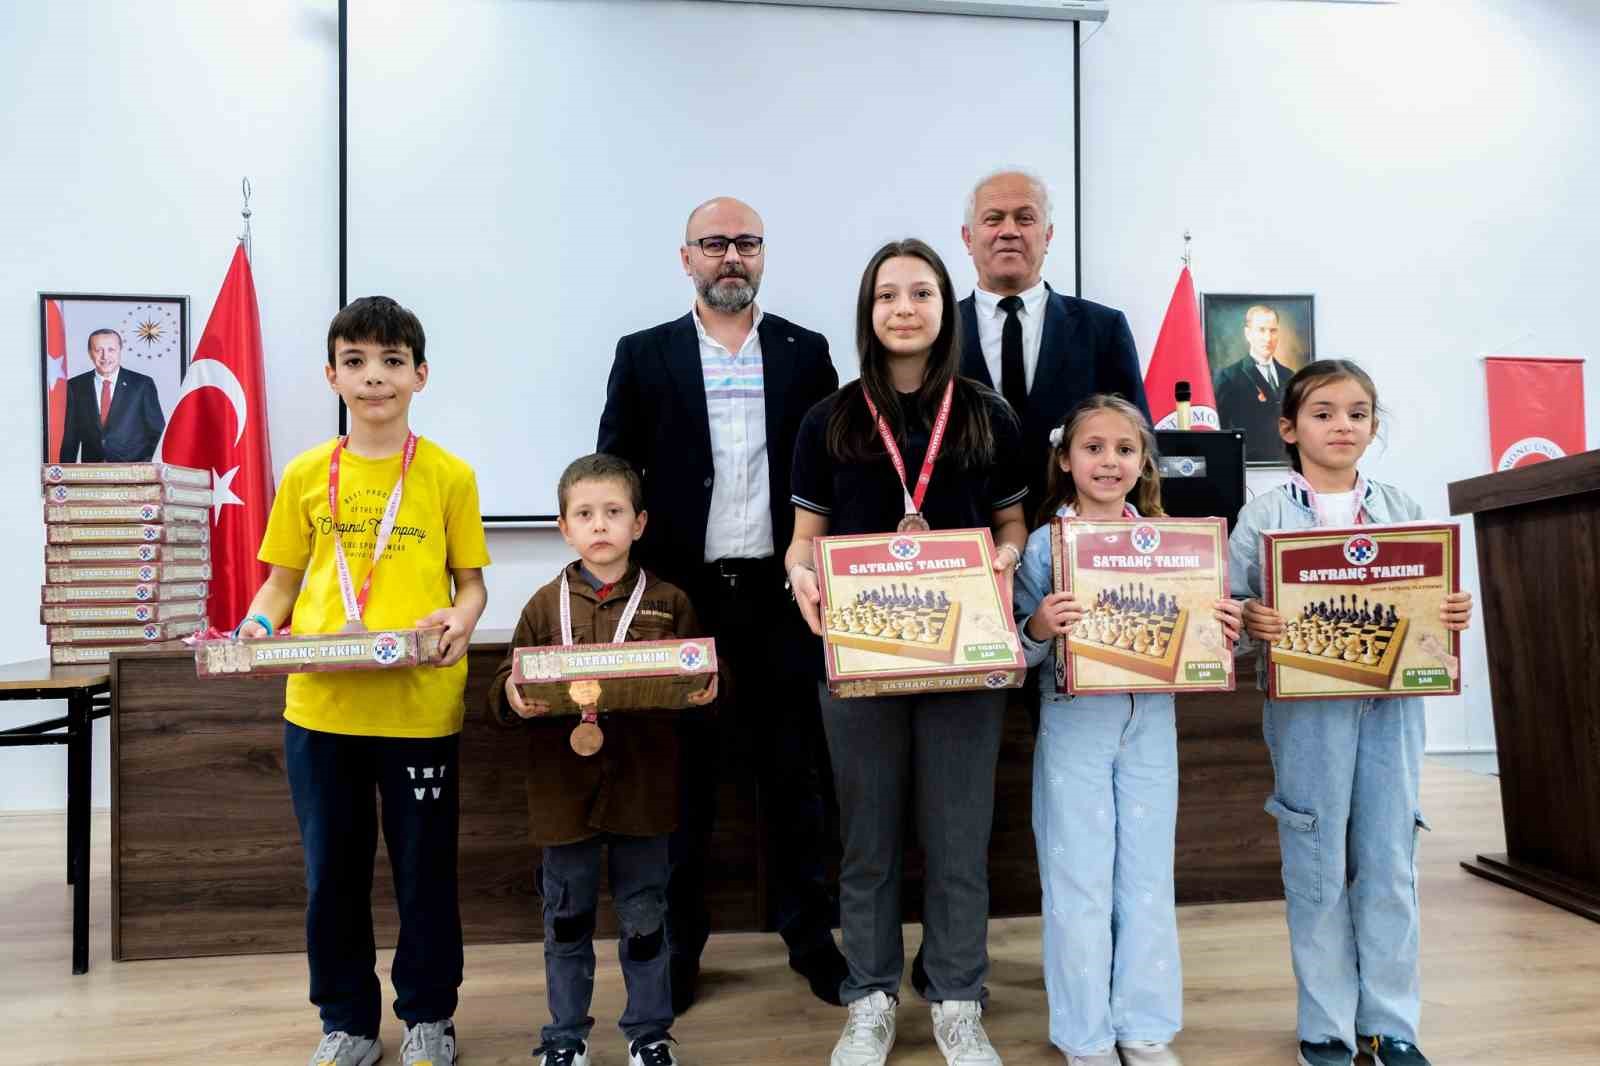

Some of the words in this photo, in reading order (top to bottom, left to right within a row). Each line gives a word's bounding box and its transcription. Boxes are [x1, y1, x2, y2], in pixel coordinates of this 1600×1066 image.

[369, 518, 427, 543] Cmpany
[360, 541, 405, 551] SPORWEAR
[849, 560, 914, 574] SATRANÇ
[916, 558, 967, 570] TAKIMI
[1093, 555, 1152, 569] SATRANÇ
[1154, 555, 1200, 568] TAKIMI
[1299, 567, 1367, 582] SATRANÇ
[1370, 564, 1425, 578] TAKIMI
[320, 644, 366, 657] TAKIMI
[628, 651, 670, 663] TAKIMI
